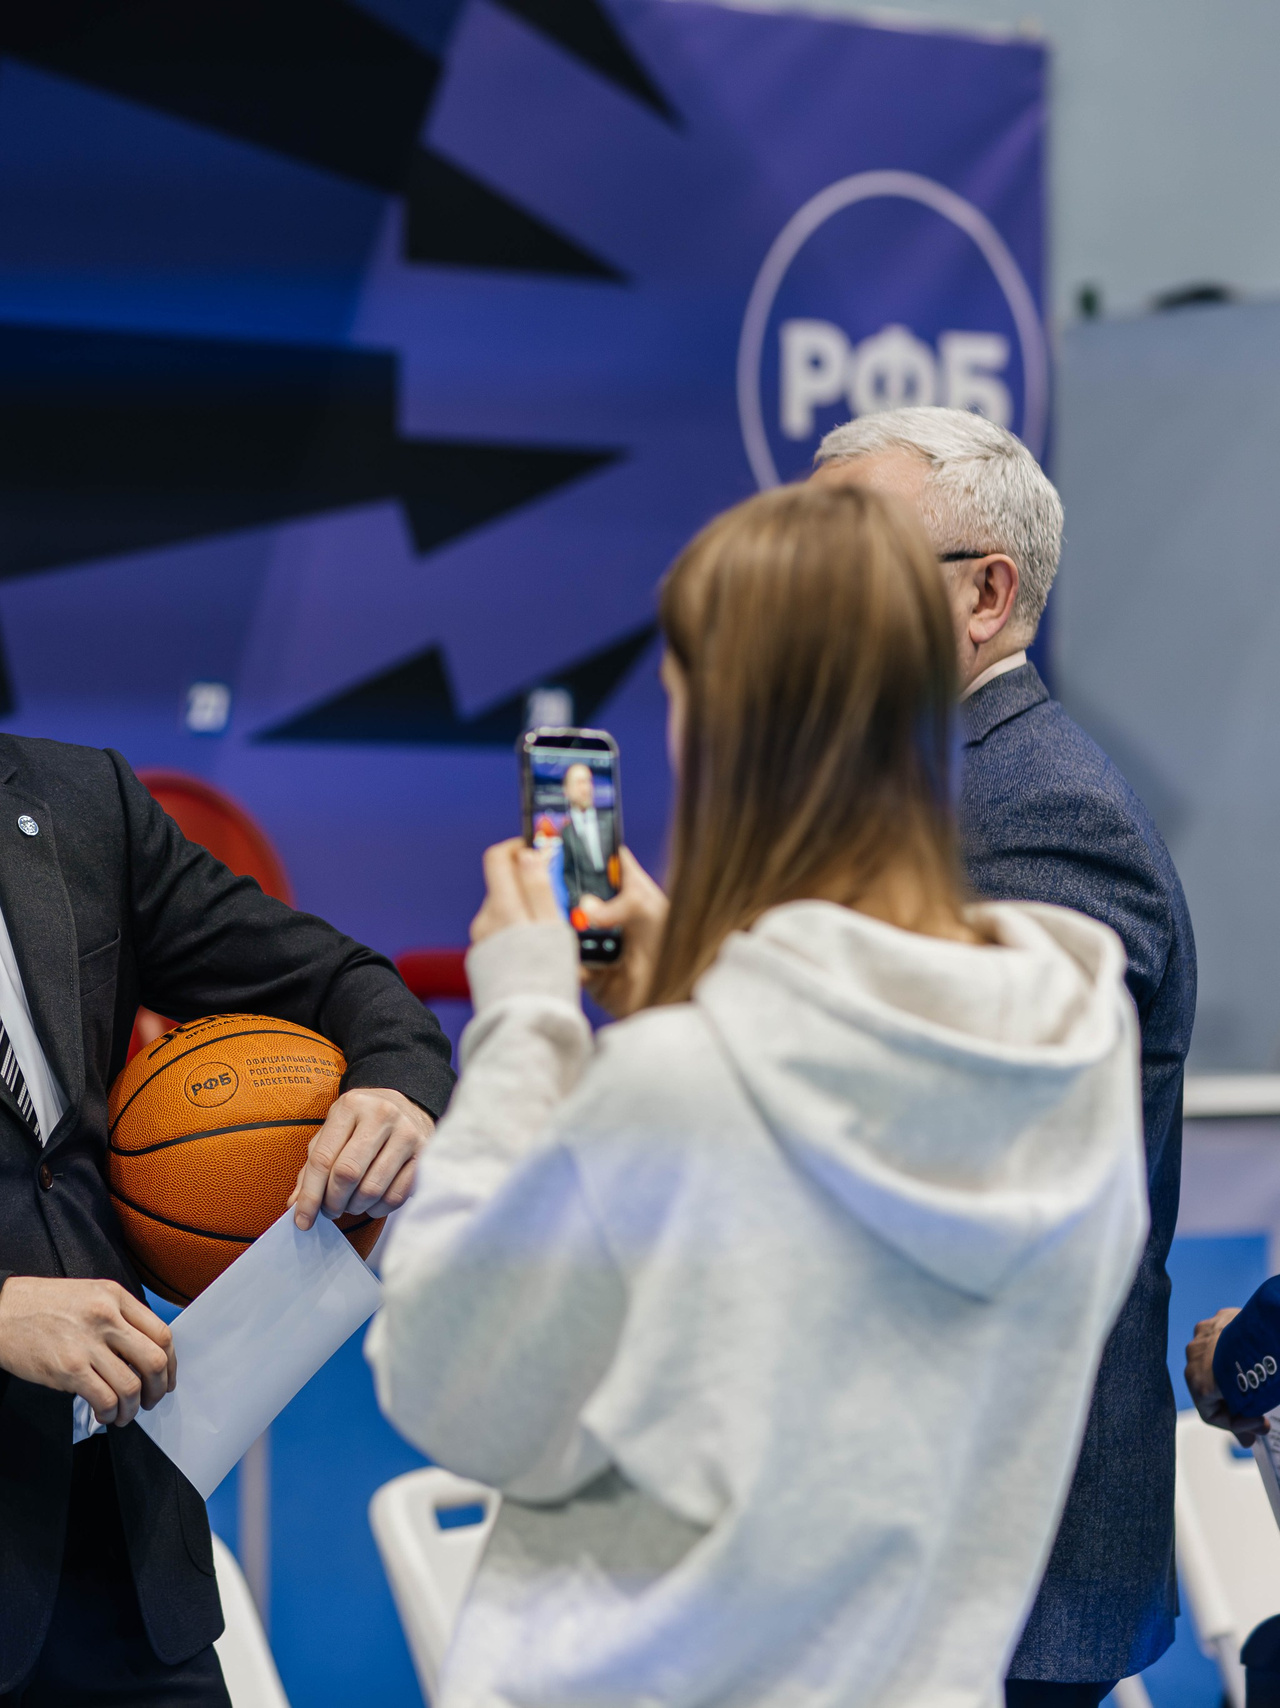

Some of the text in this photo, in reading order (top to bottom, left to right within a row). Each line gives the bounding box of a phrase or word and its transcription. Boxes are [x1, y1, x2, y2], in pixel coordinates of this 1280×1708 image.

[779, 318, 1013, 441] РФБ
[245, 1055, 318, 1066] ОФИЦИАЛЬНЫЙ
[249, 1064, 312, 1077] РОССИЙСКОЙ
[191, 1072, 232, 1096] РФБ
[253, 1076, 312, 1088] БАСКЕТБОЛА
